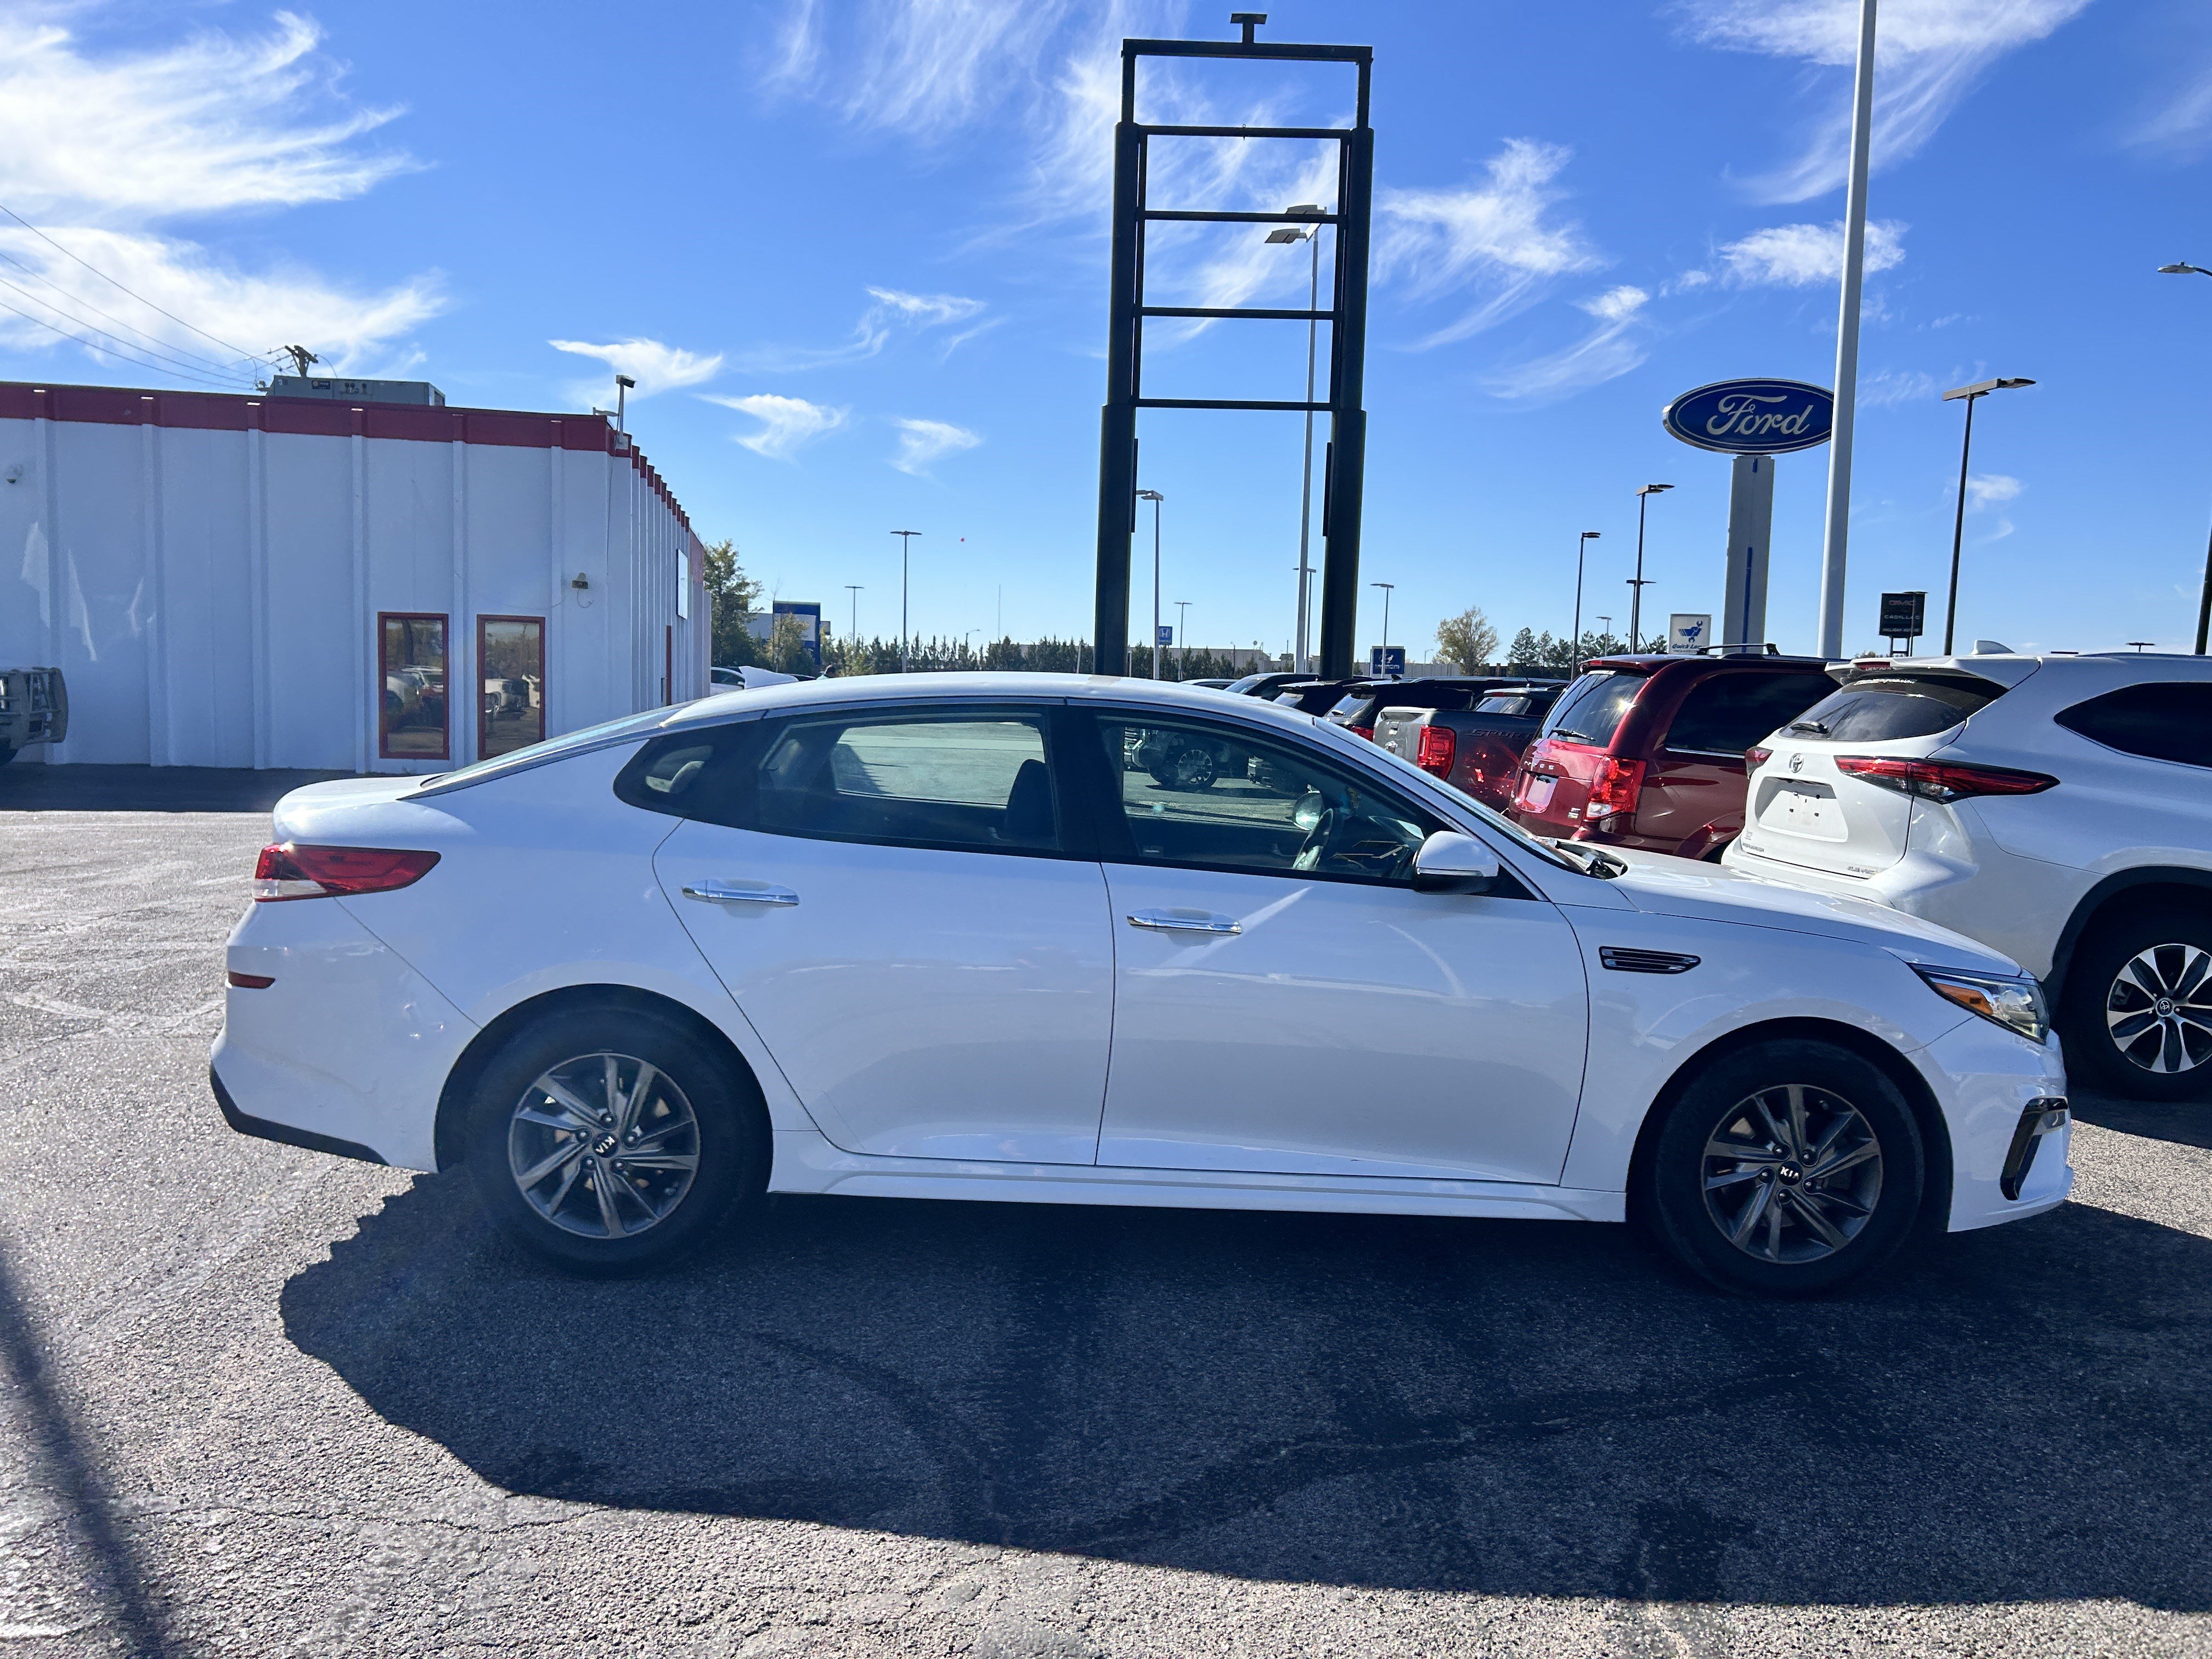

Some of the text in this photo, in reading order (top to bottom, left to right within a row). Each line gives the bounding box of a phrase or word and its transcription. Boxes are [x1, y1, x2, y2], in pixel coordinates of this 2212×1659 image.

[1706, 394, 1814, 435] Ford
[595, 1136, 615, 1153] KIA
[1781, 1166, 1799, 1180] KIA
